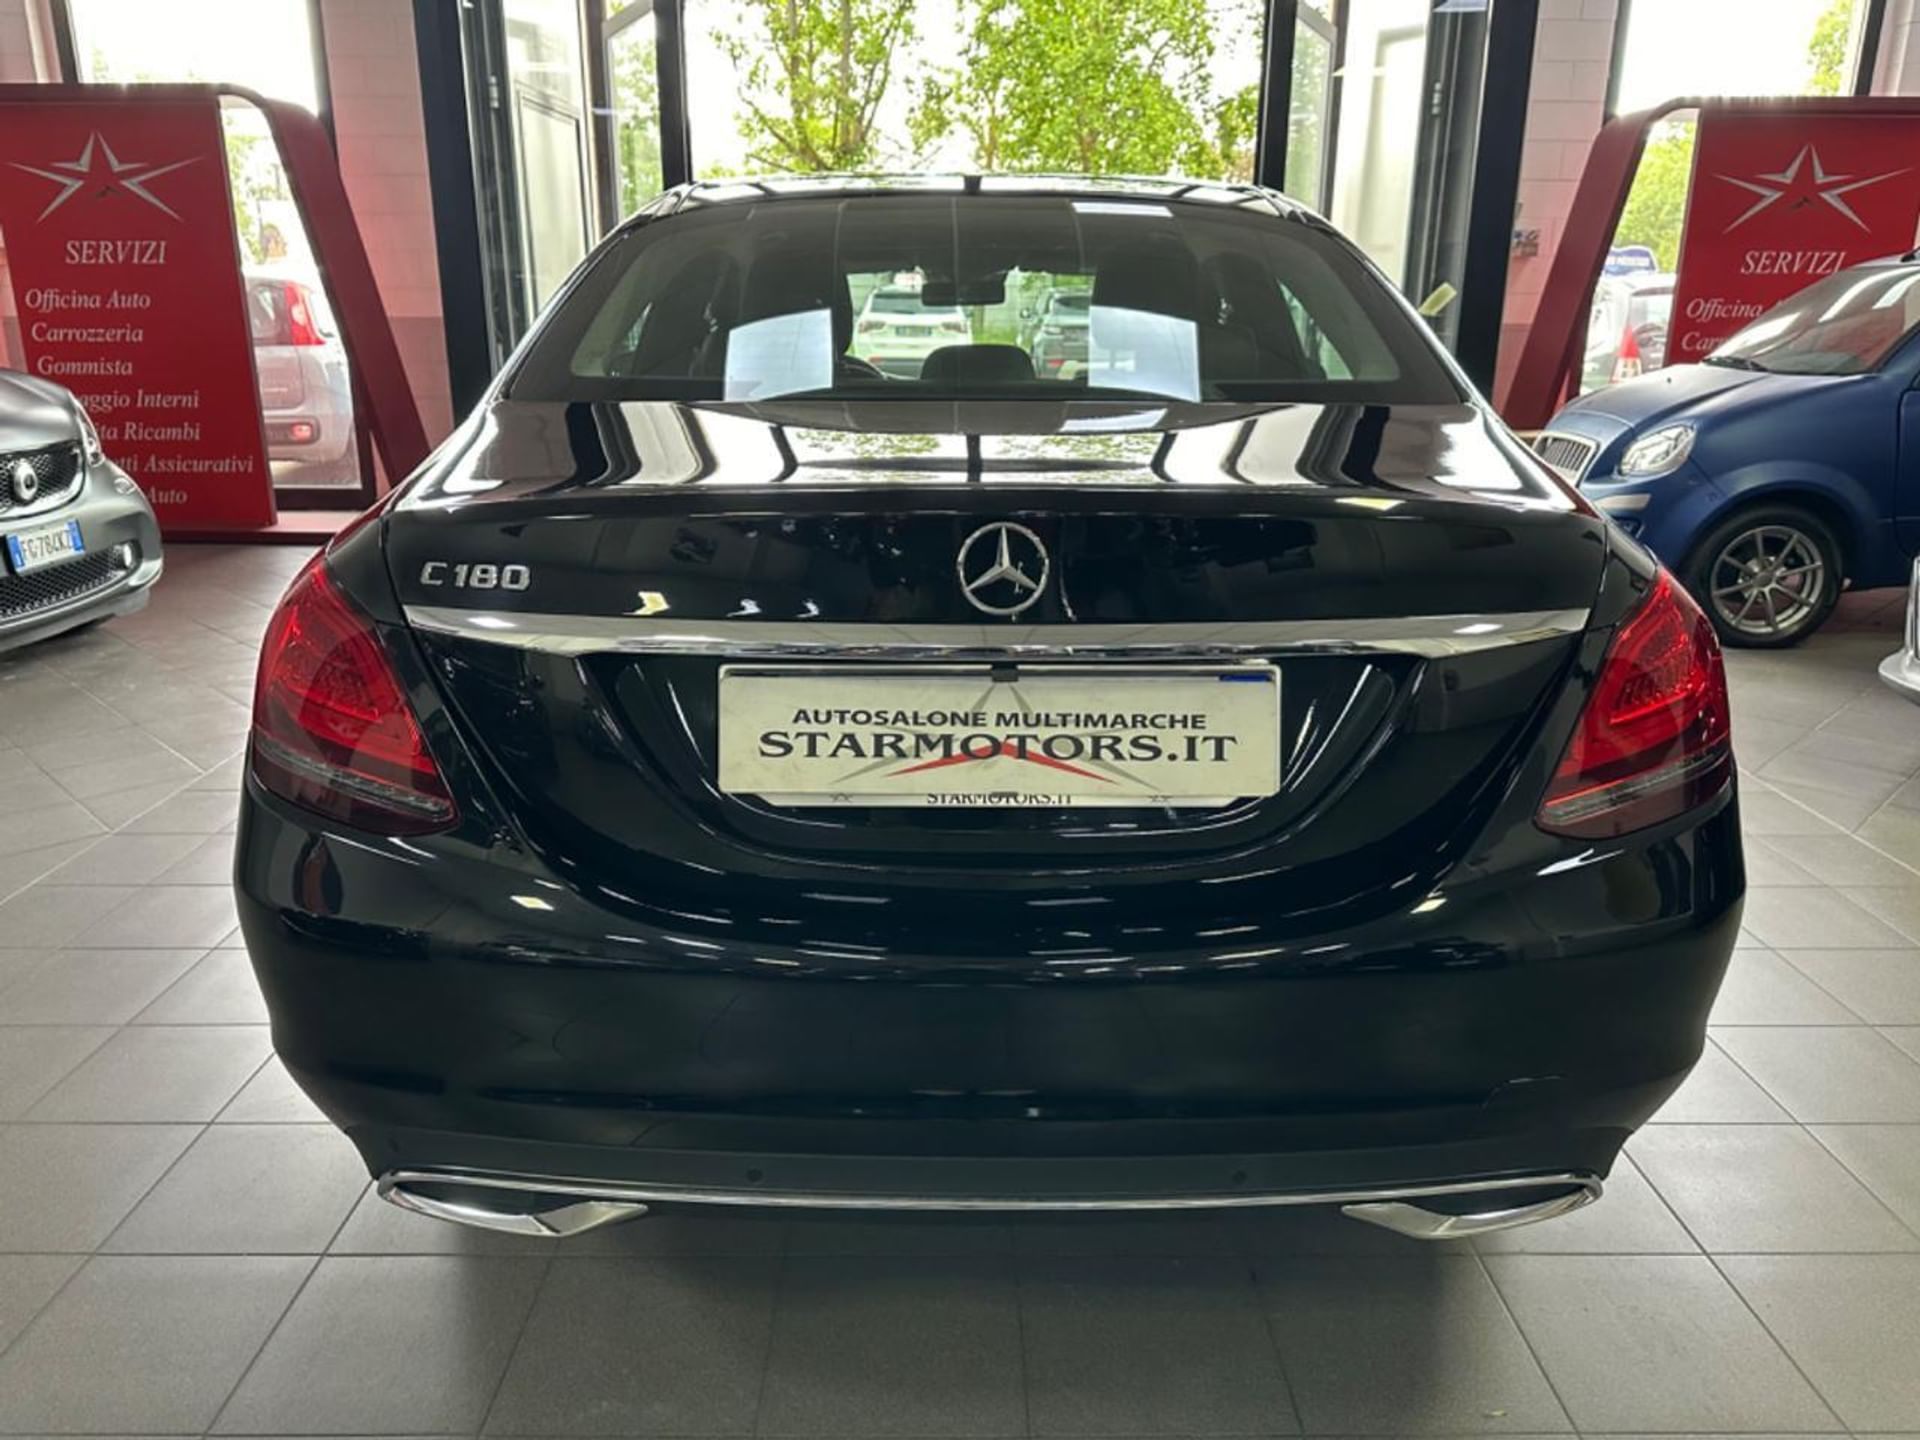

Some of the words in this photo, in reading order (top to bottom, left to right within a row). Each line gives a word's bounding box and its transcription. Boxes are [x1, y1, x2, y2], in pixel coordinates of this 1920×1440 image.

[64, 240, 167, 265] SERVIZI
[1740, 250, 1847, 275] SERVIZI
[25, 288, 101, 313] Officina
[105, 290, 152, 309] Auto
[1686, 298, 1763, 323] Officina
[31, 321, 144, 343] Carrozzeria
[36, 355, 133, 376] Gommista
[79, 390, 131, 413] aggio
[136, 389, 199, 409] Interni
[123, 421, 201, 441] Ricambi
[143, 453, 254, 474] Assicurativi
[146, 485, 188, 504] Auto
[419, 561, 448, 585] C
[453, 563, 531, 591] 180
[791, 708, 987, 729] AUTOSALONE
[994, 711, 1207, 731] MULTIMARCHE
[758, 731, 1238, 762] STARMOTORS.IT
